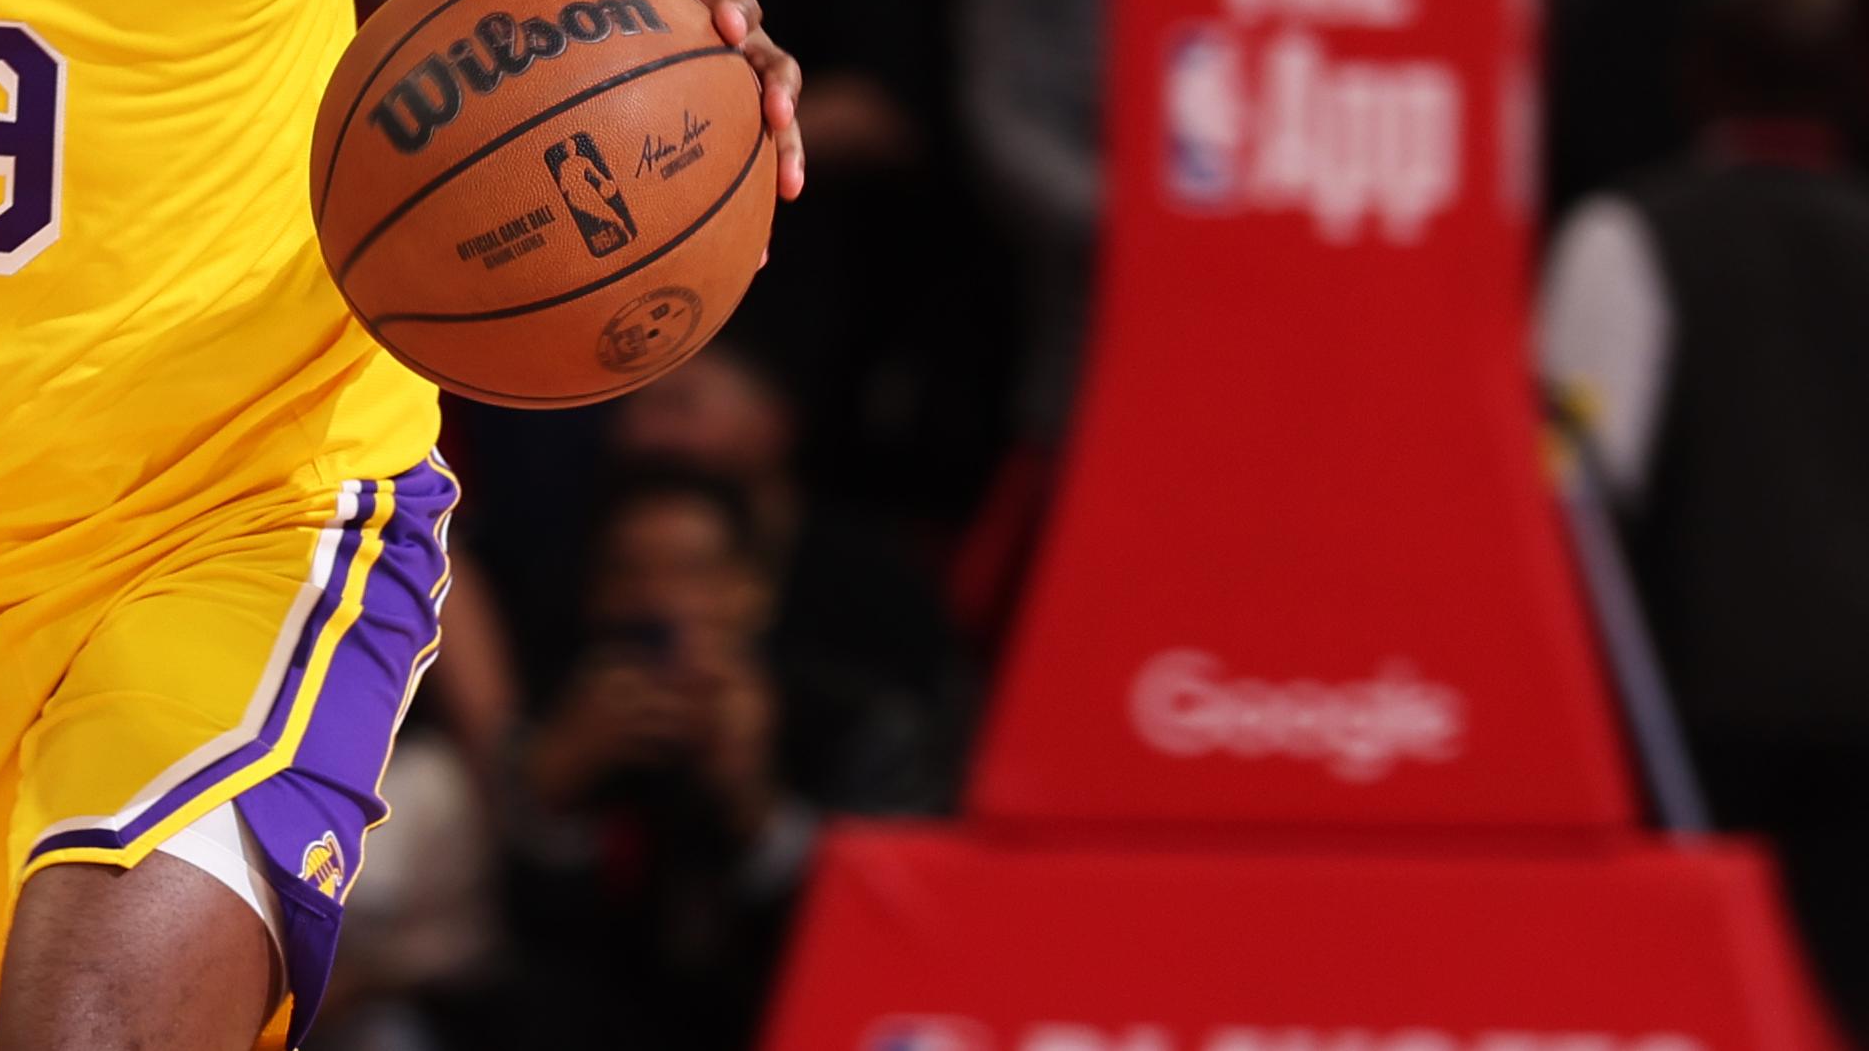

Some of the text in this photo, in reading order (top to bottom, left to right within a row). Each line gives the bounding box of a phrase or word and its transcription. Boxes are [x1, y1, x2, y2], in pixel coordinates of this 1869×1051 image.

[1248, 33, 1462, 244] App
[498, 215, 531, 243] GAME
[526, 204, 556, 230] BALL
[1129, 648, 1468, 784] Google
